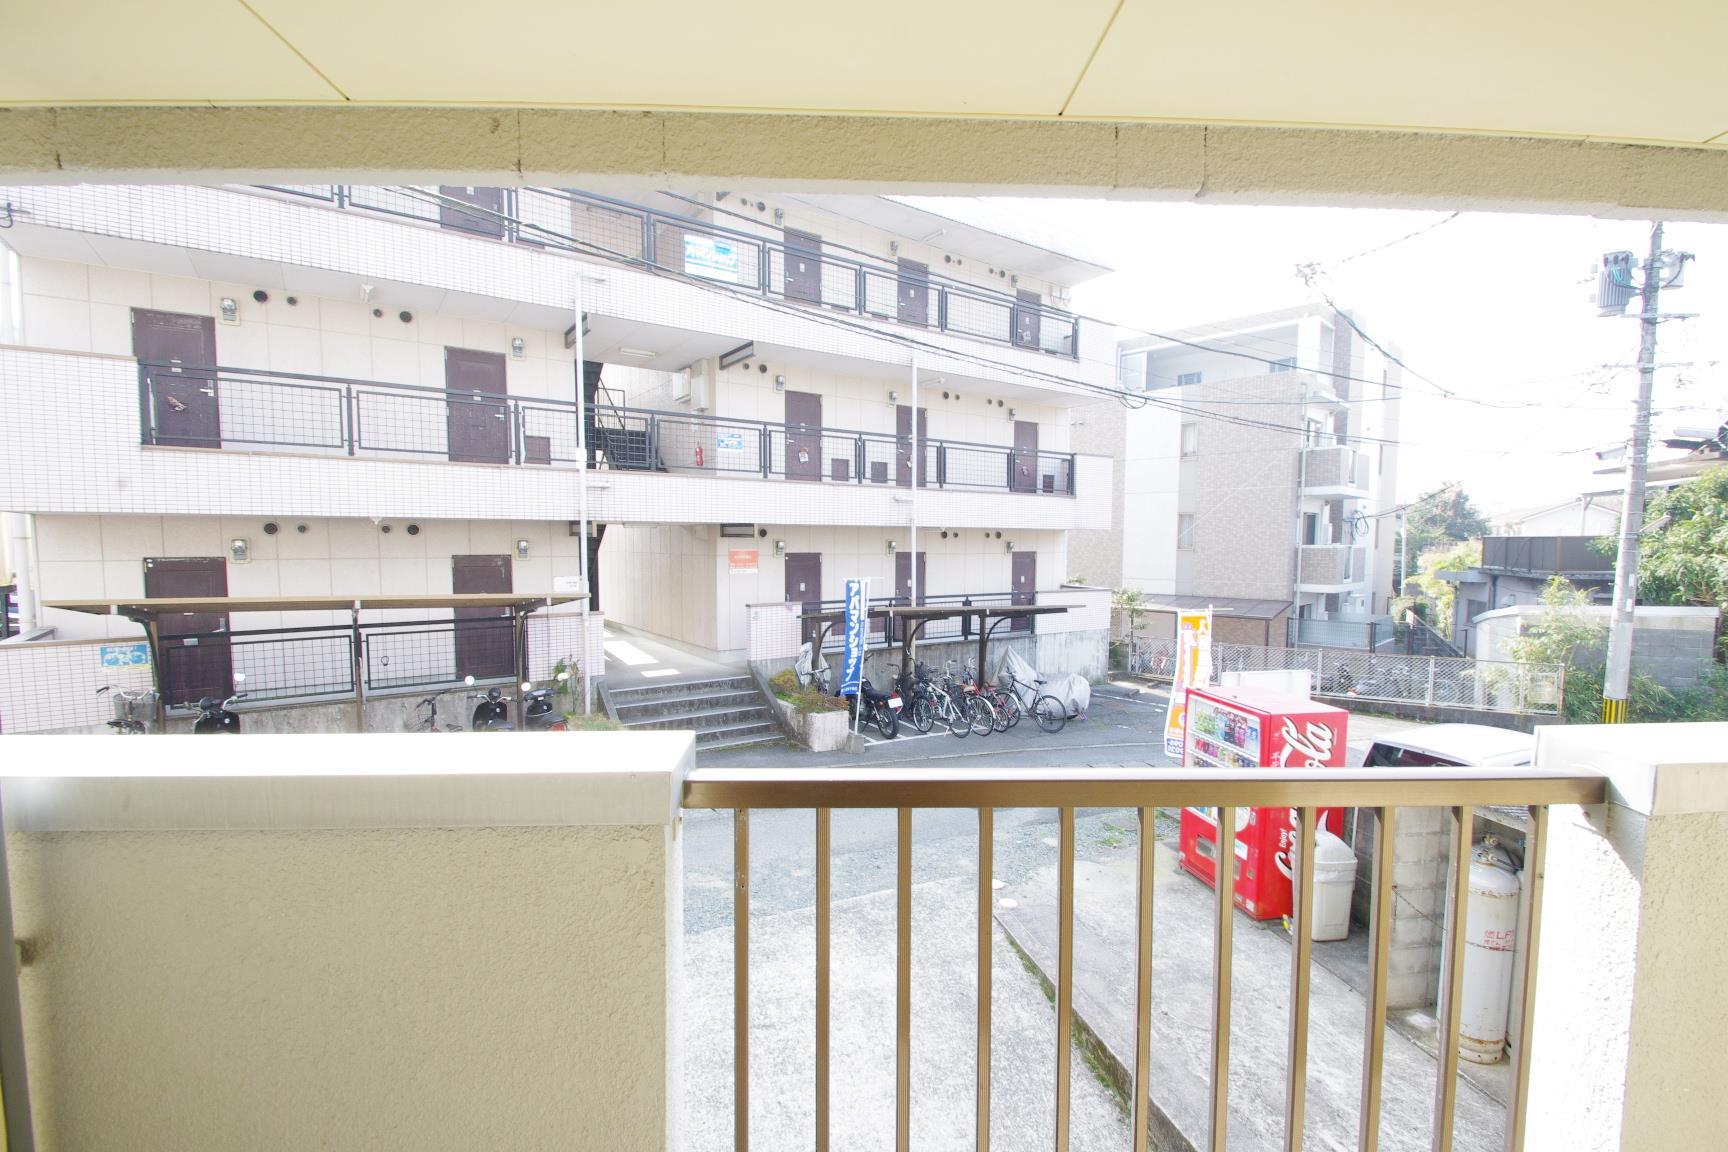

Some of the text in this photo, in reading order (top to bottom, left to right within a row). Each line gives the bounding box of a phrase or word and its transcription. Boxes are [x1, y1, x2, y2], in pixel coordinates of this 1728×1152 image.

[846, 582, 860, 682] アパマンショップ
